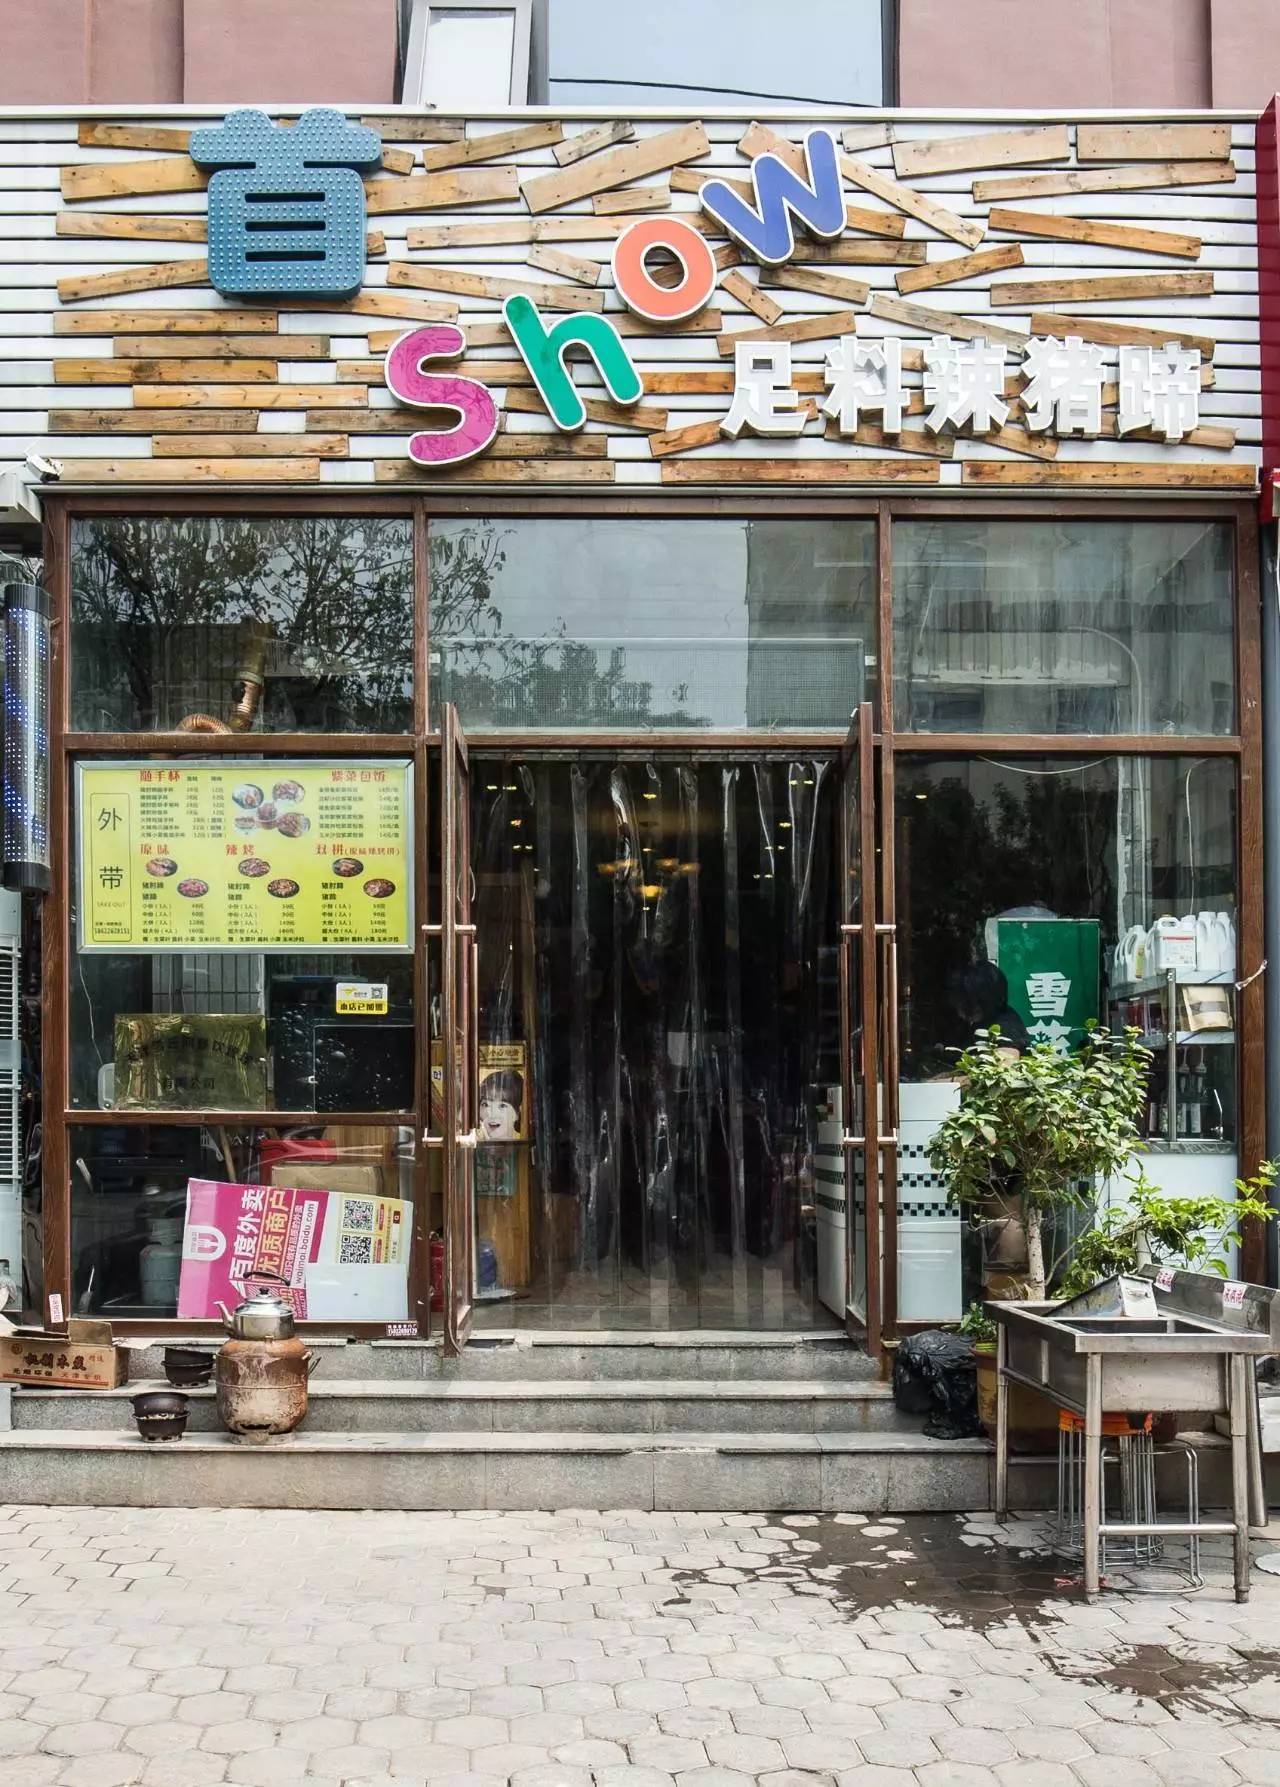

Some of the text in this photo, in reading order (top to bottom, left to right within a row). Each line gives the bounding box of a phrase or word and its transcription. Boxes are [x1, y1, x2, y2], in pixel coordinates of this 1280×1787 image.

[719, 335, 1203, 444] 足料辣猪蹄
[98, 807, 123, 890] 外带
[229, 1188, 266, 1280] 百度外卖
[285, 1204, 304, 1281] 们只做有品质的外卖
[295, 1202, 316, 1285] waimai.baidu.com
